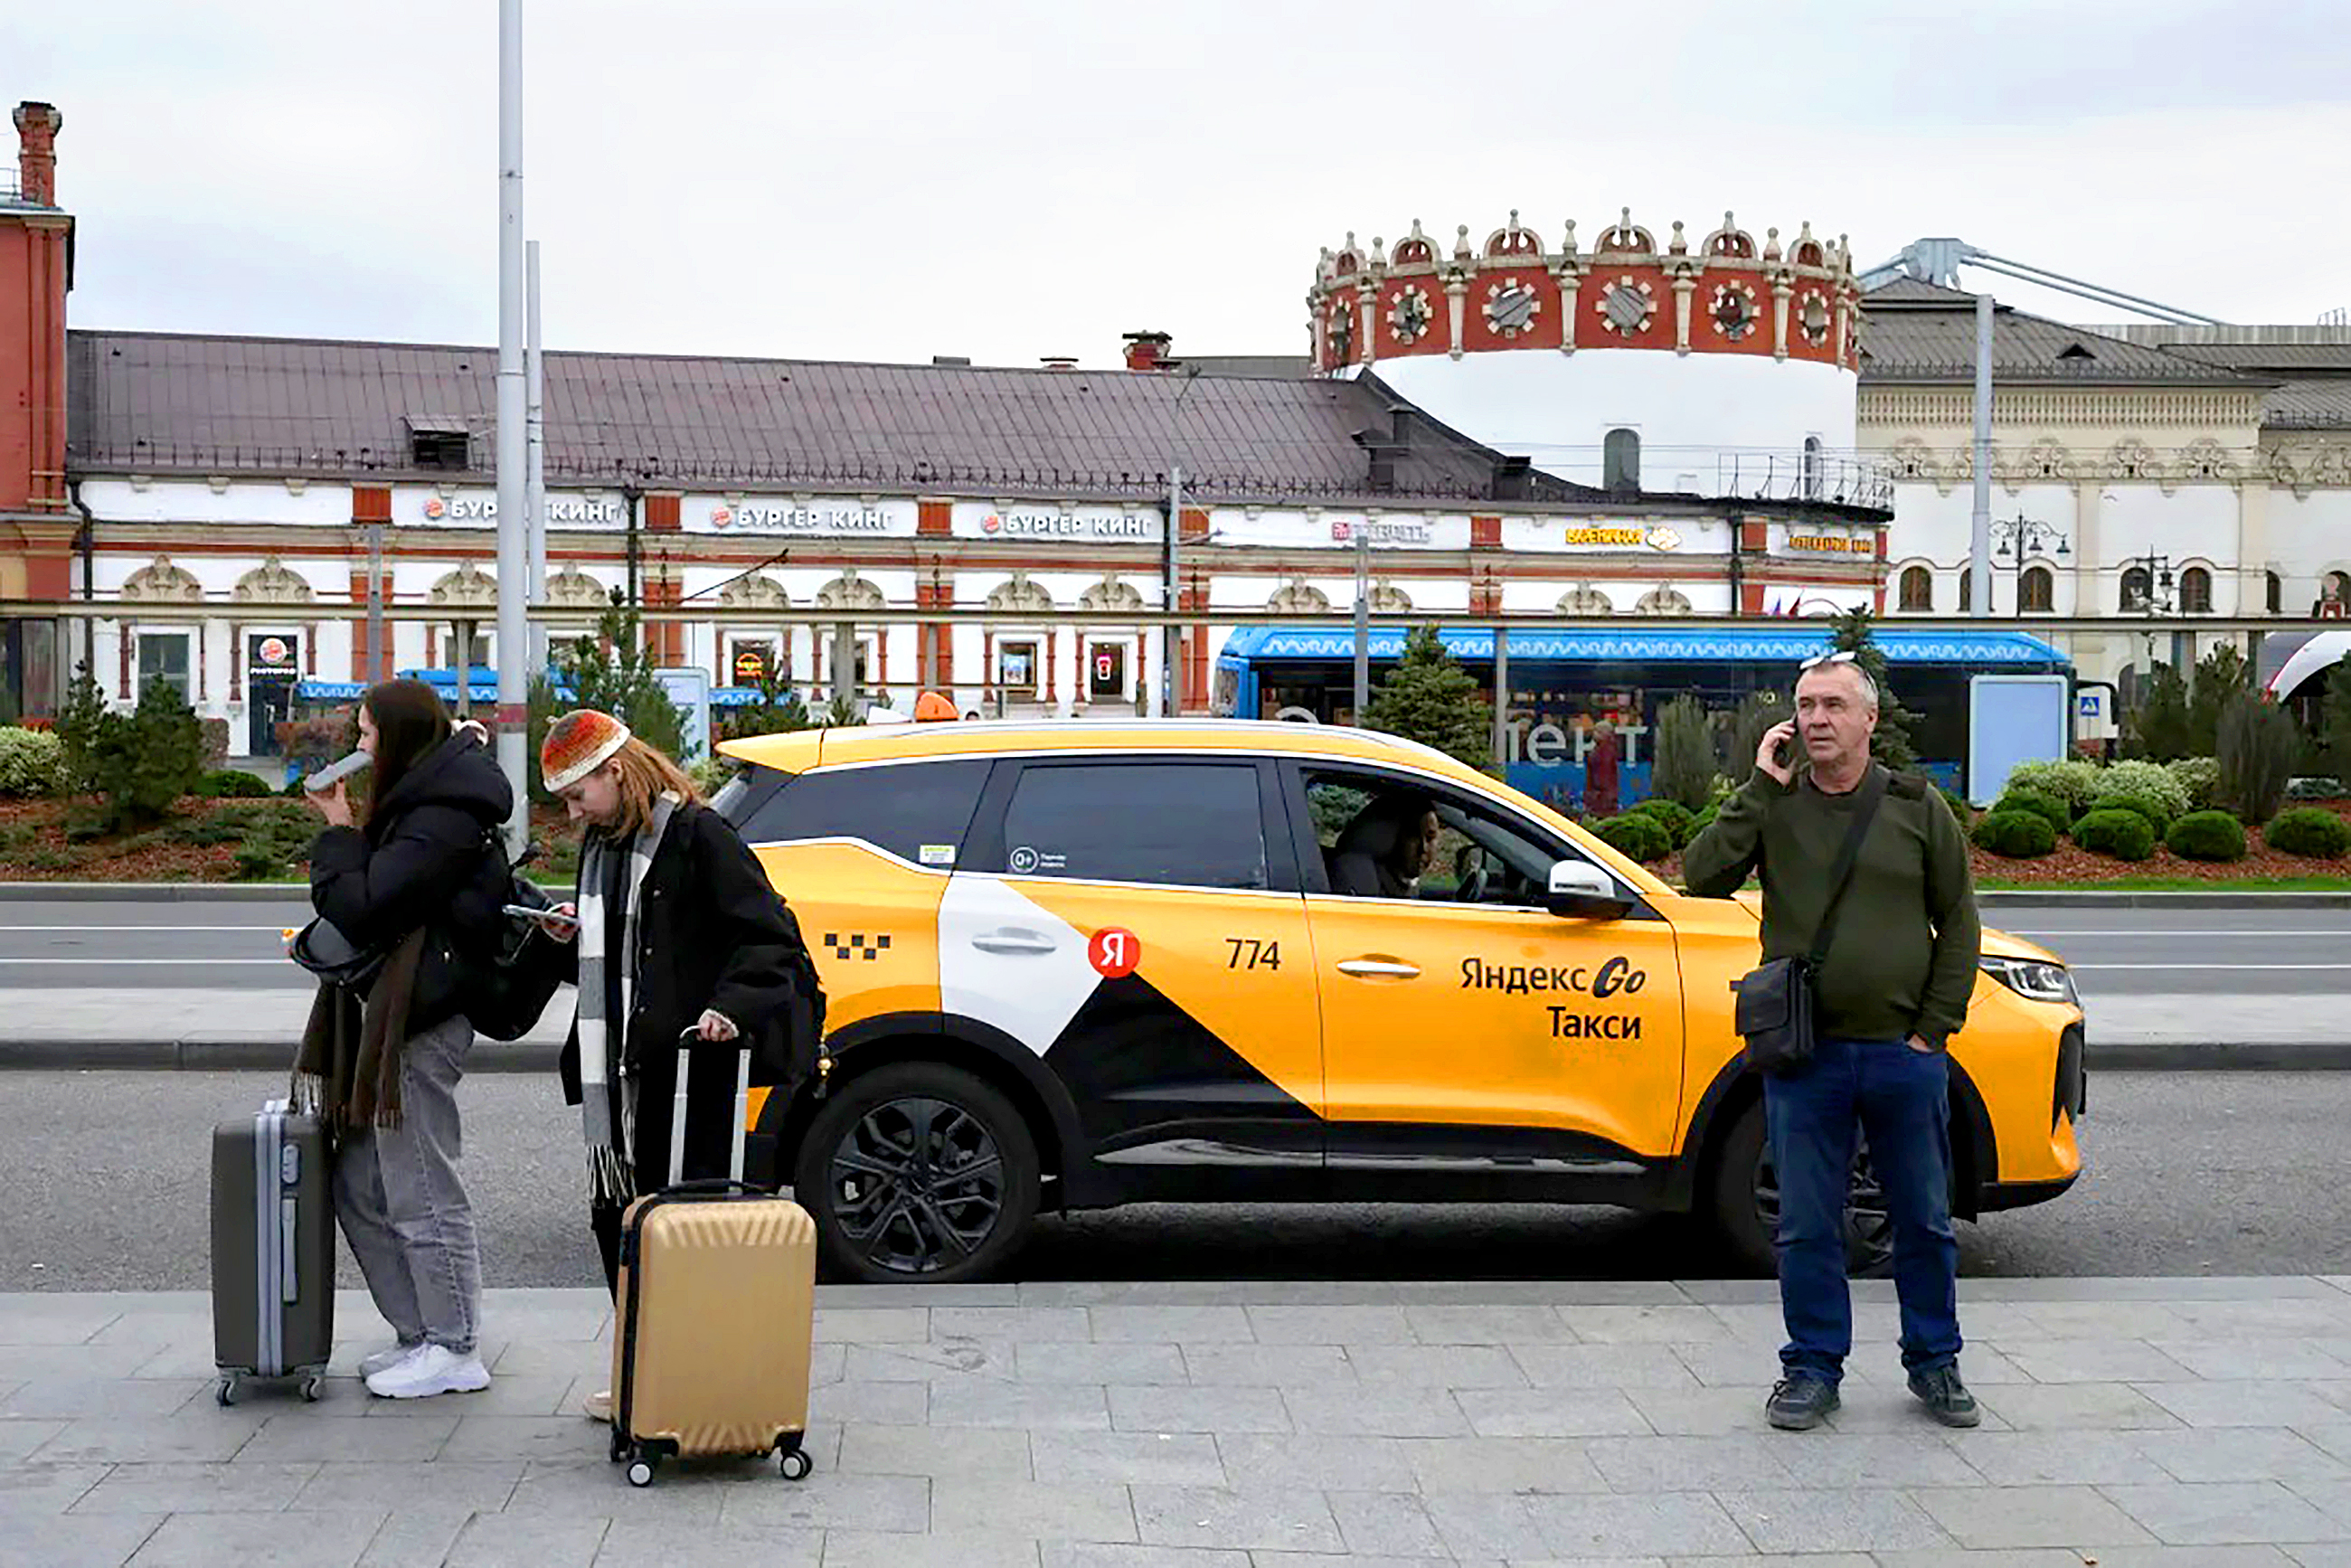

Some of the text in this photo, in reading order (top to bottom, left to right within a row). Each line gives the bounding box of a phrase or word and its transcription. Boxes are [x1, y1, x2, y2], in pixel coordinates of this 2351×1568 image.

[450, 500, 618, 522] БУР КИНГ
[737, 508, 893, 530] БУРГЕР КИНГ
[1006, 514, 1152, 535] БУРГЕР КИНГ
[1100, 932, 1125, 967] Я
[1225, 938, 1282, 970] 774
[1461, 955, 1647, 998] Яндекс Go
[1545, 1006, 1641, 1040] Такси
